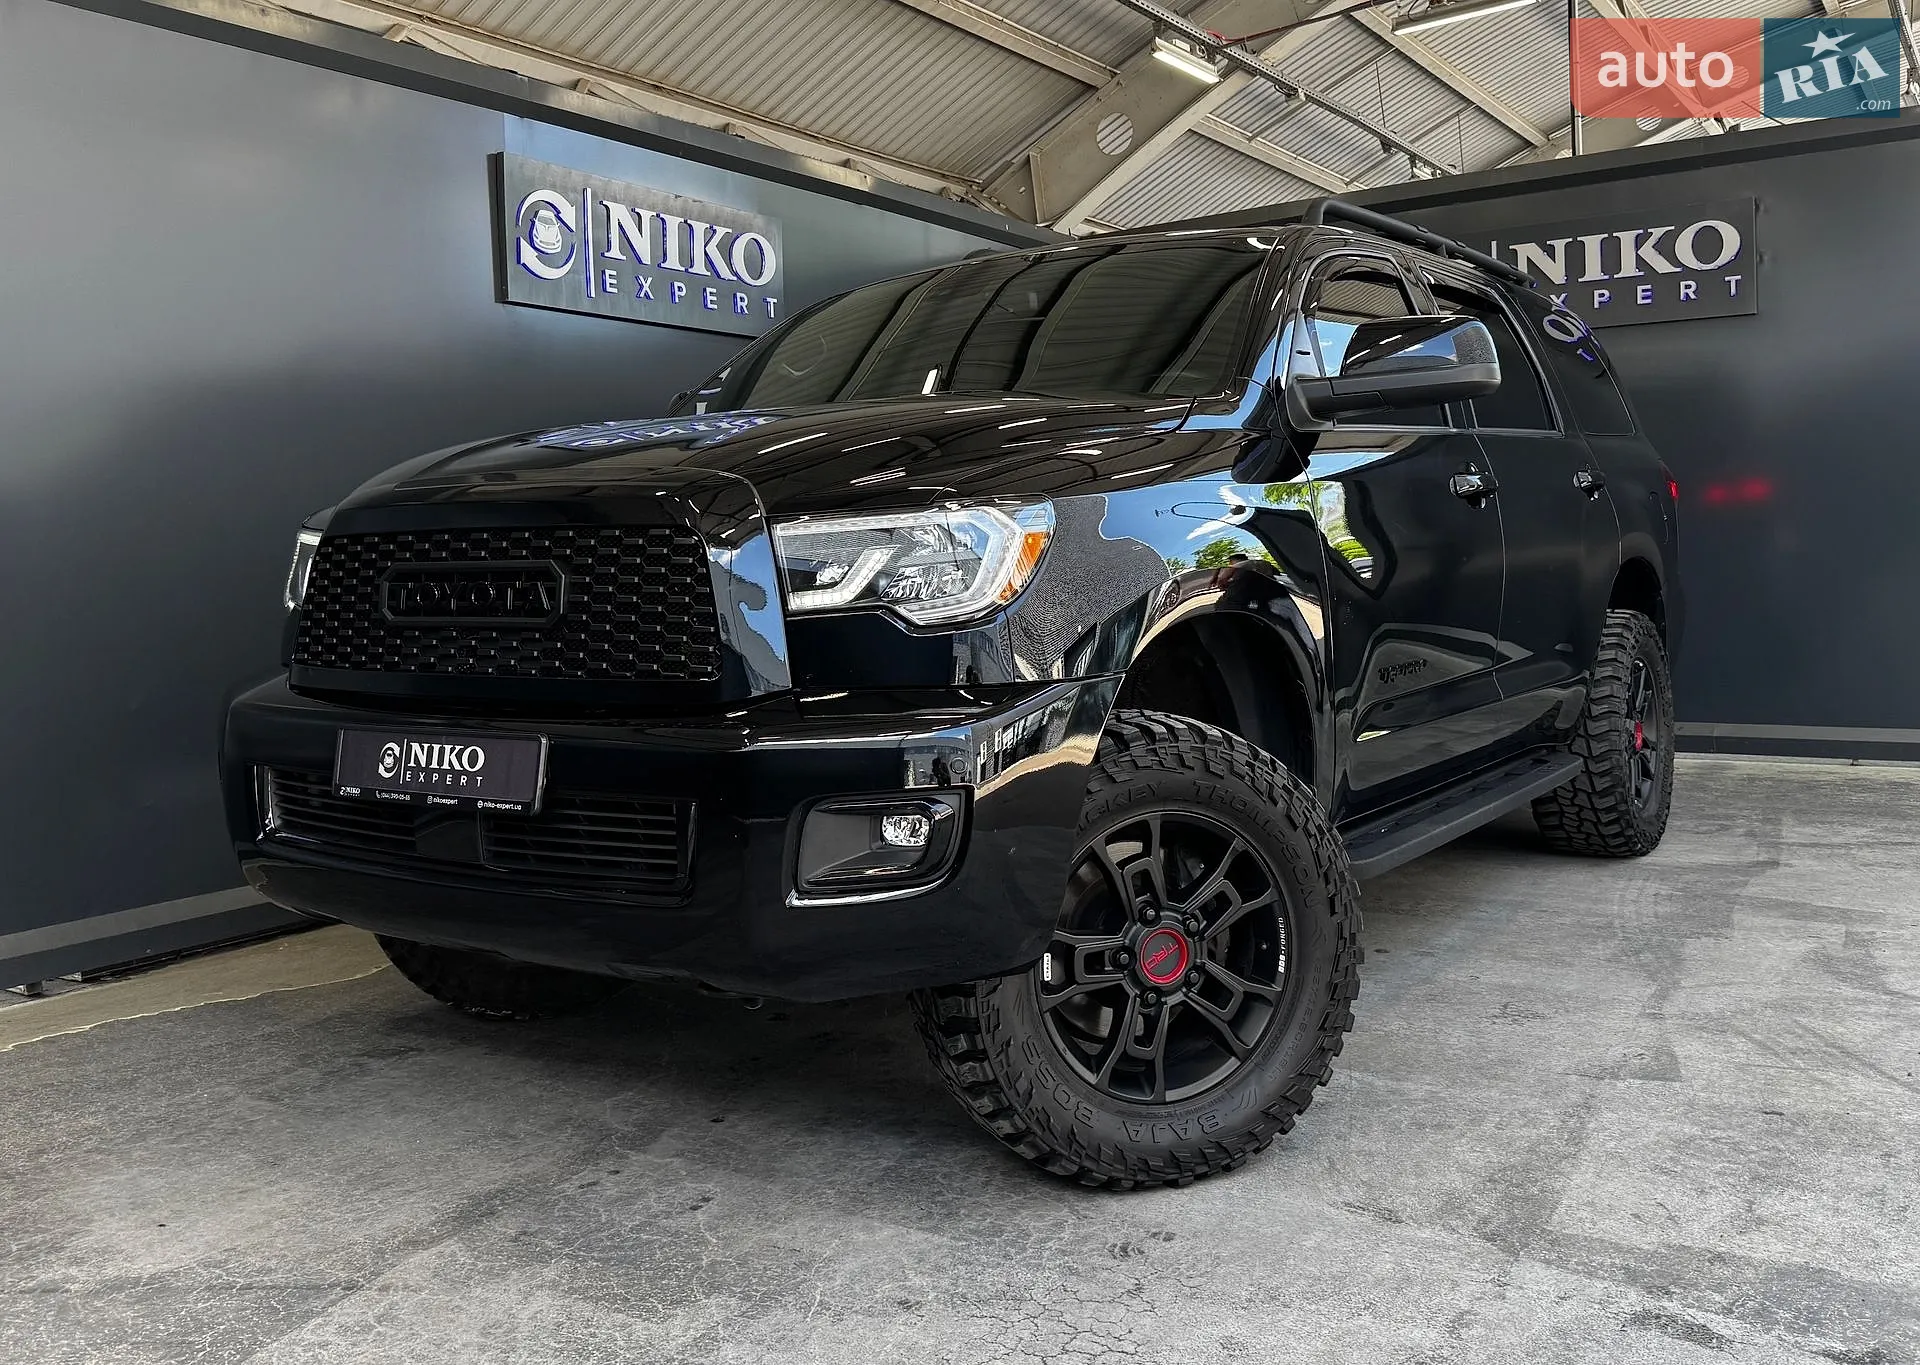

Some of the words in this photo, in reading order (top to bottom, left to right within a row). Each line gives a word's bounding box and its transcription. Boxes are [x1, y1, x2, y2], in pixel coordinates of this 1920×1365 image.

[600, 200, 776, 286] NIKO
[1509, 220, 1741, 285] NIKO
[602, 269, 778, 318] EXPERT
[1549, 275, 1742, 309] XPERT
[390, 580, 552, 611] TOYOTA
[407, 742, 485, 772] NIKO
[405, 771, 483, 788] EXPERT
[1121, 1110, 1226, 1145] BAJA
